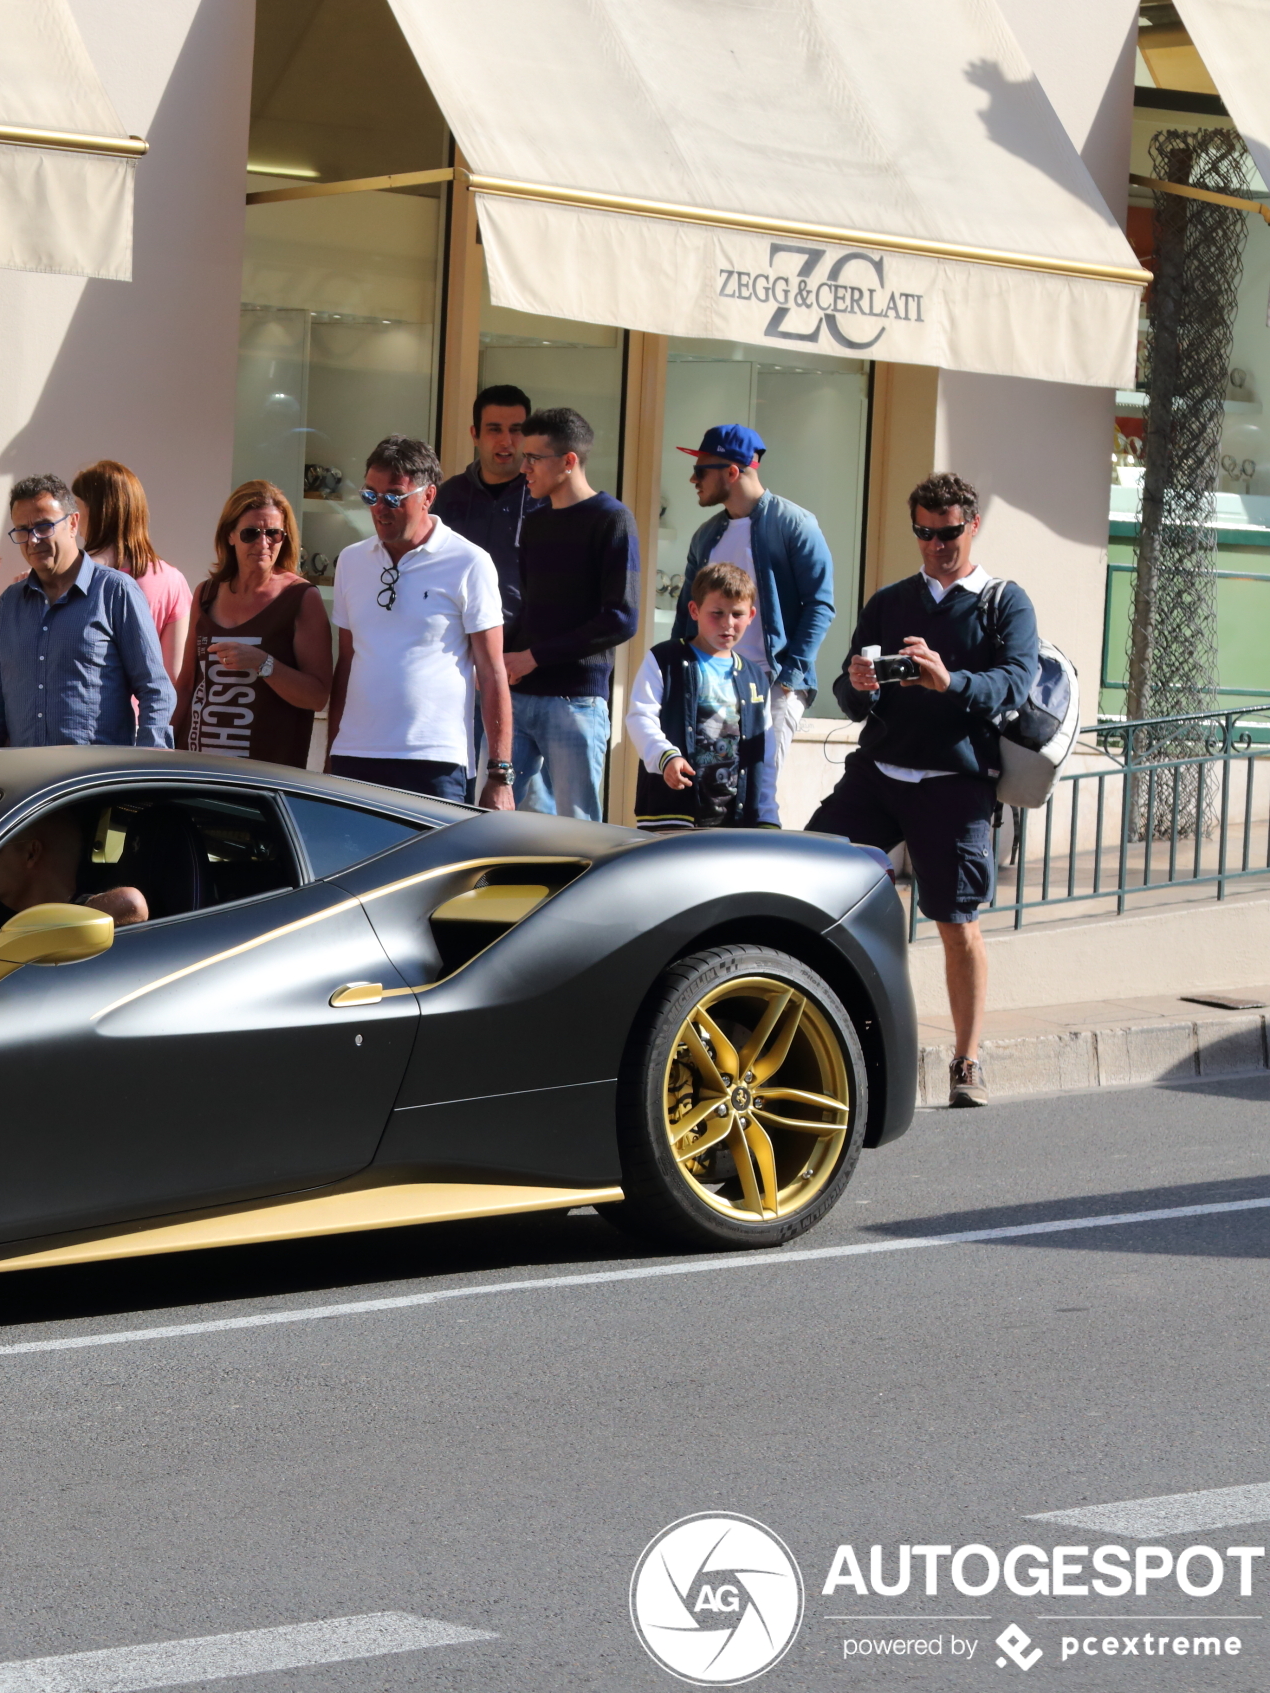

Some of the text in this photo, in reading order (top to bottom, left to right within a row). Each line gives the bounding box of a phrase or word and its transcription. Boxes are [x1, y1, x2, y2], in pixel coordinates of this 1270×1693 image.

[718, 268, 791, 306] ZEGG
[815, 281, 925, 323] CERLATI
[749, 682, 764, 703] L
[668, 968, 717, 1023] MICHELIN
